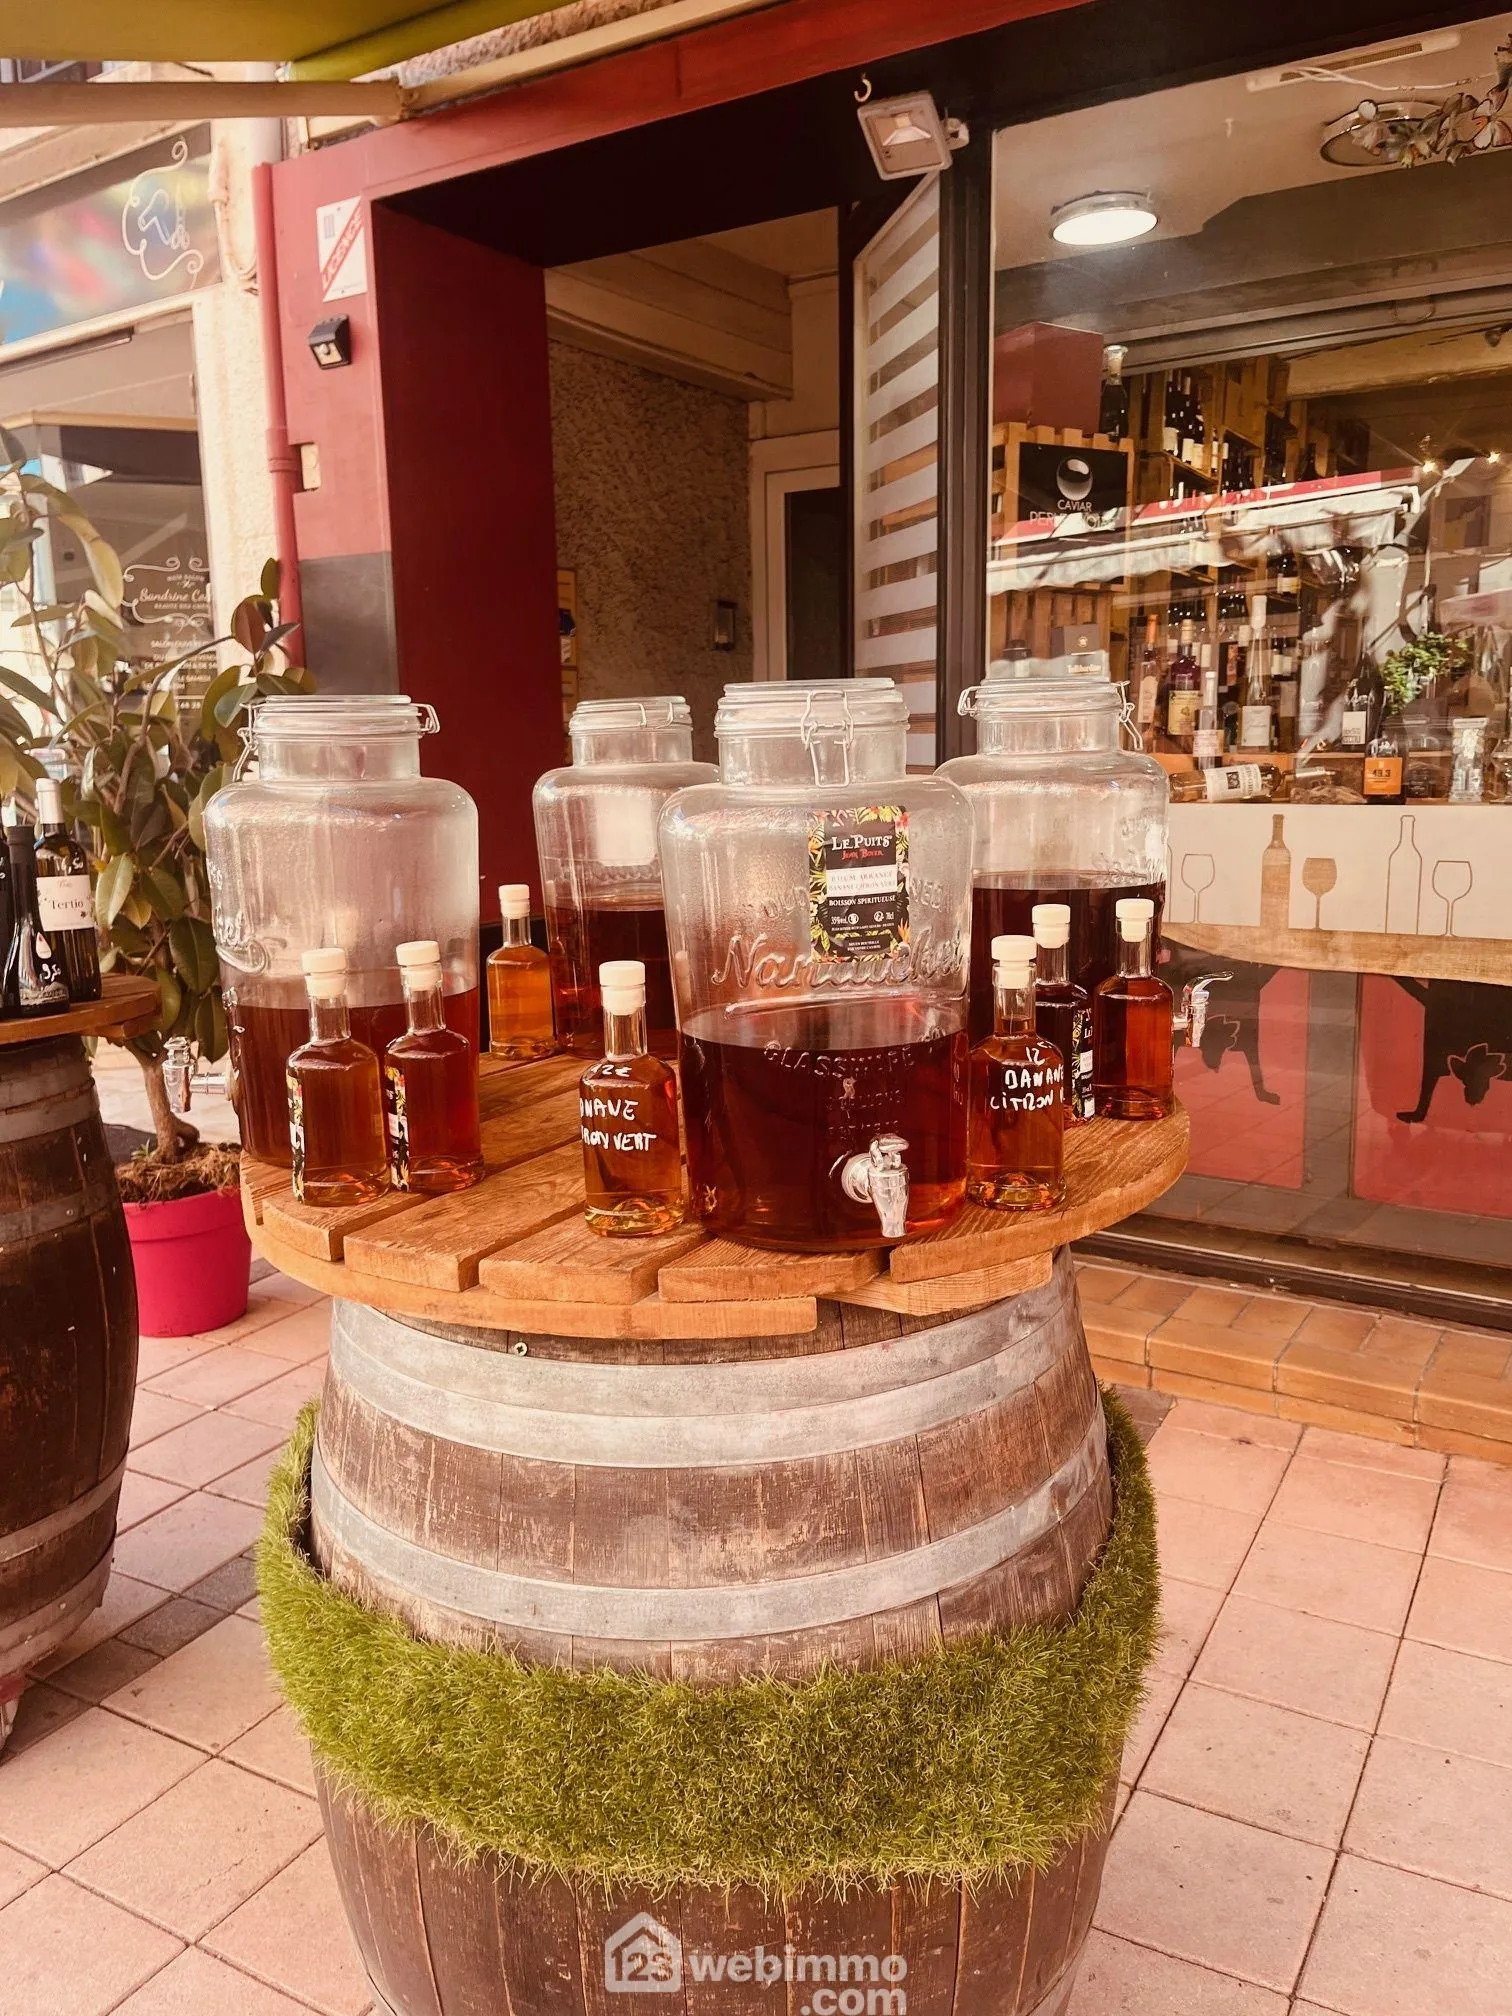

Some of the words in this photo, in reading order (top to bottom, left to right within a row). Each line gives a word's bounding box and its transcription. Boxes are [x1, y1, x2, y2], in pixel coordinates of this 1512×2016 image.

[1057, 500, 1092, 512] CAVIAR
[831, 836, 855, 851] LE
[850, 834, 892, 849] PUITS
[51, 899, 84, 910] Tertio
[829, 899, 857, 907] BOISSON
[857, 895, 896, 905] SPIRITUEUSE
[990, 1089, 1054, 1111] CITRON
[613, 1132, 657, 1151] VERT
